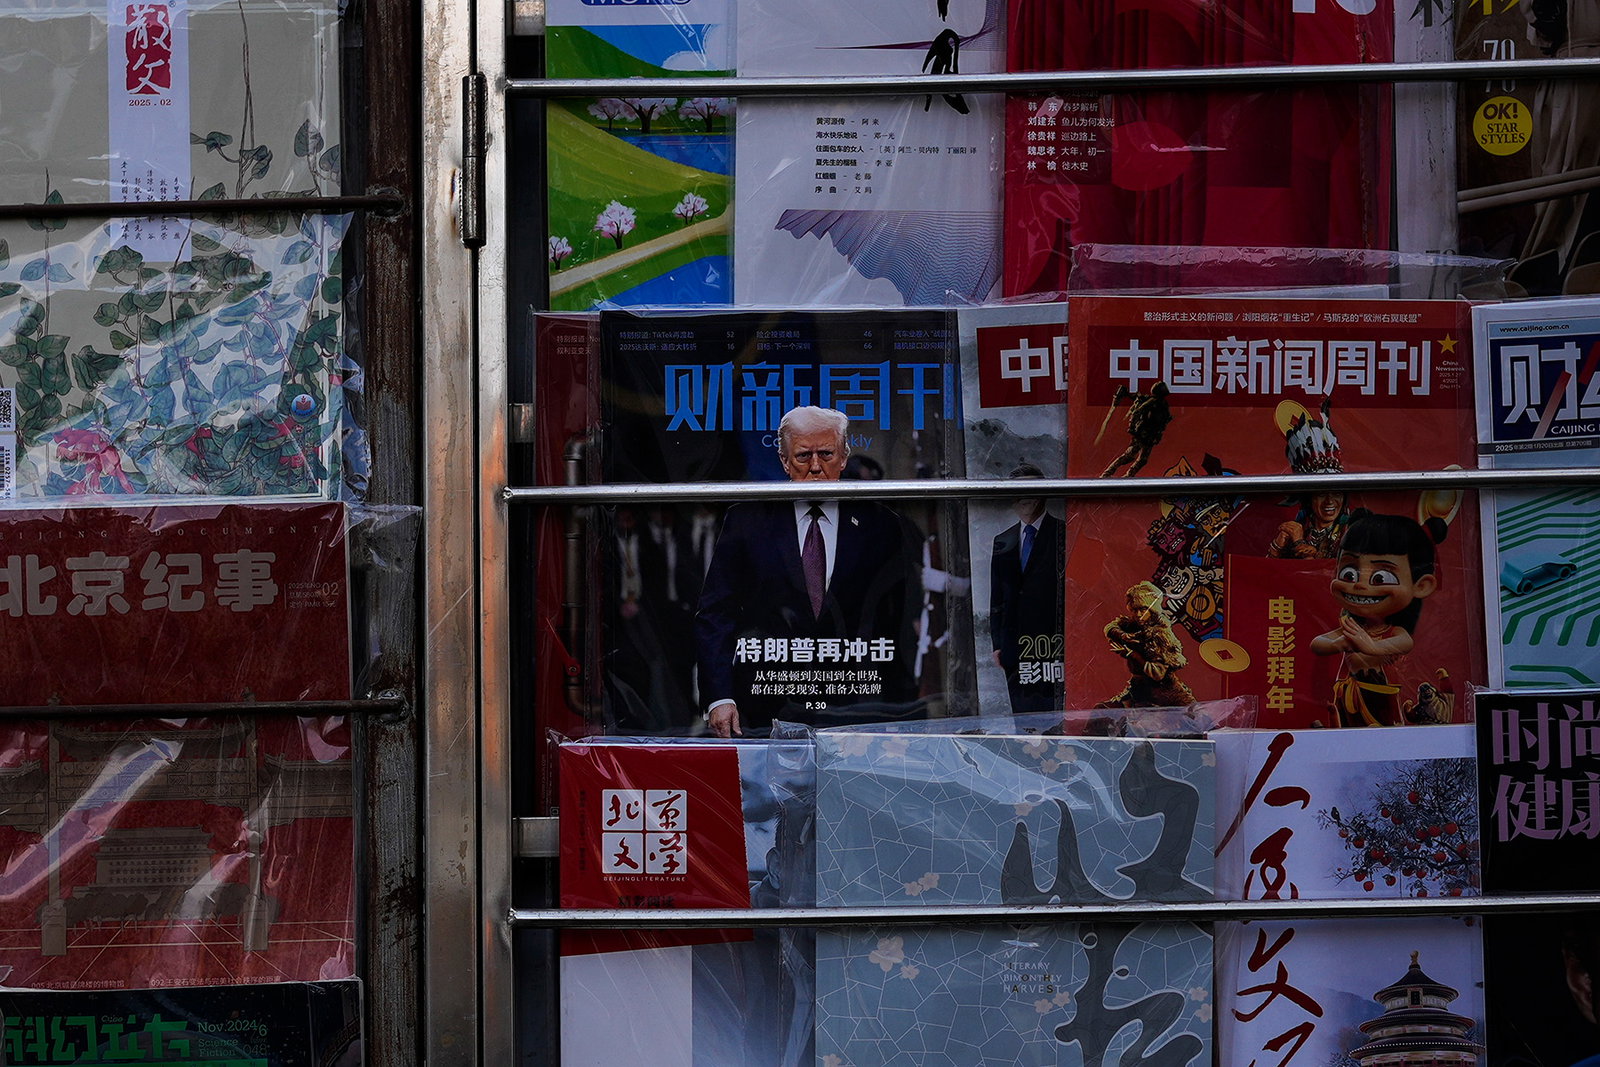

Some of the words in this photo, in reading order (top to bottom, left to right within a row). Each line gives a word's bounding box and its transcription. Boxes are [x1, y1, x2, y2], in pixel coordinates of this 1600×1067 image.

[1483, 103, 1519, 120] OK!
[1027, 116, 1057, 126] 刘建东
[1061, 117, 1115, 127] 鱼儿为何发光
[1487, 123, 1519, 134] STAR
[1027, 131, 1057, 141] 徐贵祥
[1061, 132, 1097, 142] 巡边路上
[1480, 133, 1526, 145] STYLES
[1027, 145, 1057, 156] 魏思孝
[1143, 311, 1235, 322] 整治形式主义的新问题
[1499, 323, 1570, 333] www.caijing.com.cn
[1109, 335, 1432, 397] 中国新闻周刊
[1550, 422, 1597, 436] CAIJING
[0, 547, 279, 618] 北京纪事
[736, 637, 896, 663] 特朗普再冲击
[1265, 595, 1297, 714] 电影拜年
[805, 701, 828, 710] P.30
[1001, 962, 1050, 971] LITERARY
[1003, 973, 1063, 983] BIMONTHLY
[1003, 984, 1062, 994] HARVEST
[198, 1038, 239, 1048] Science
